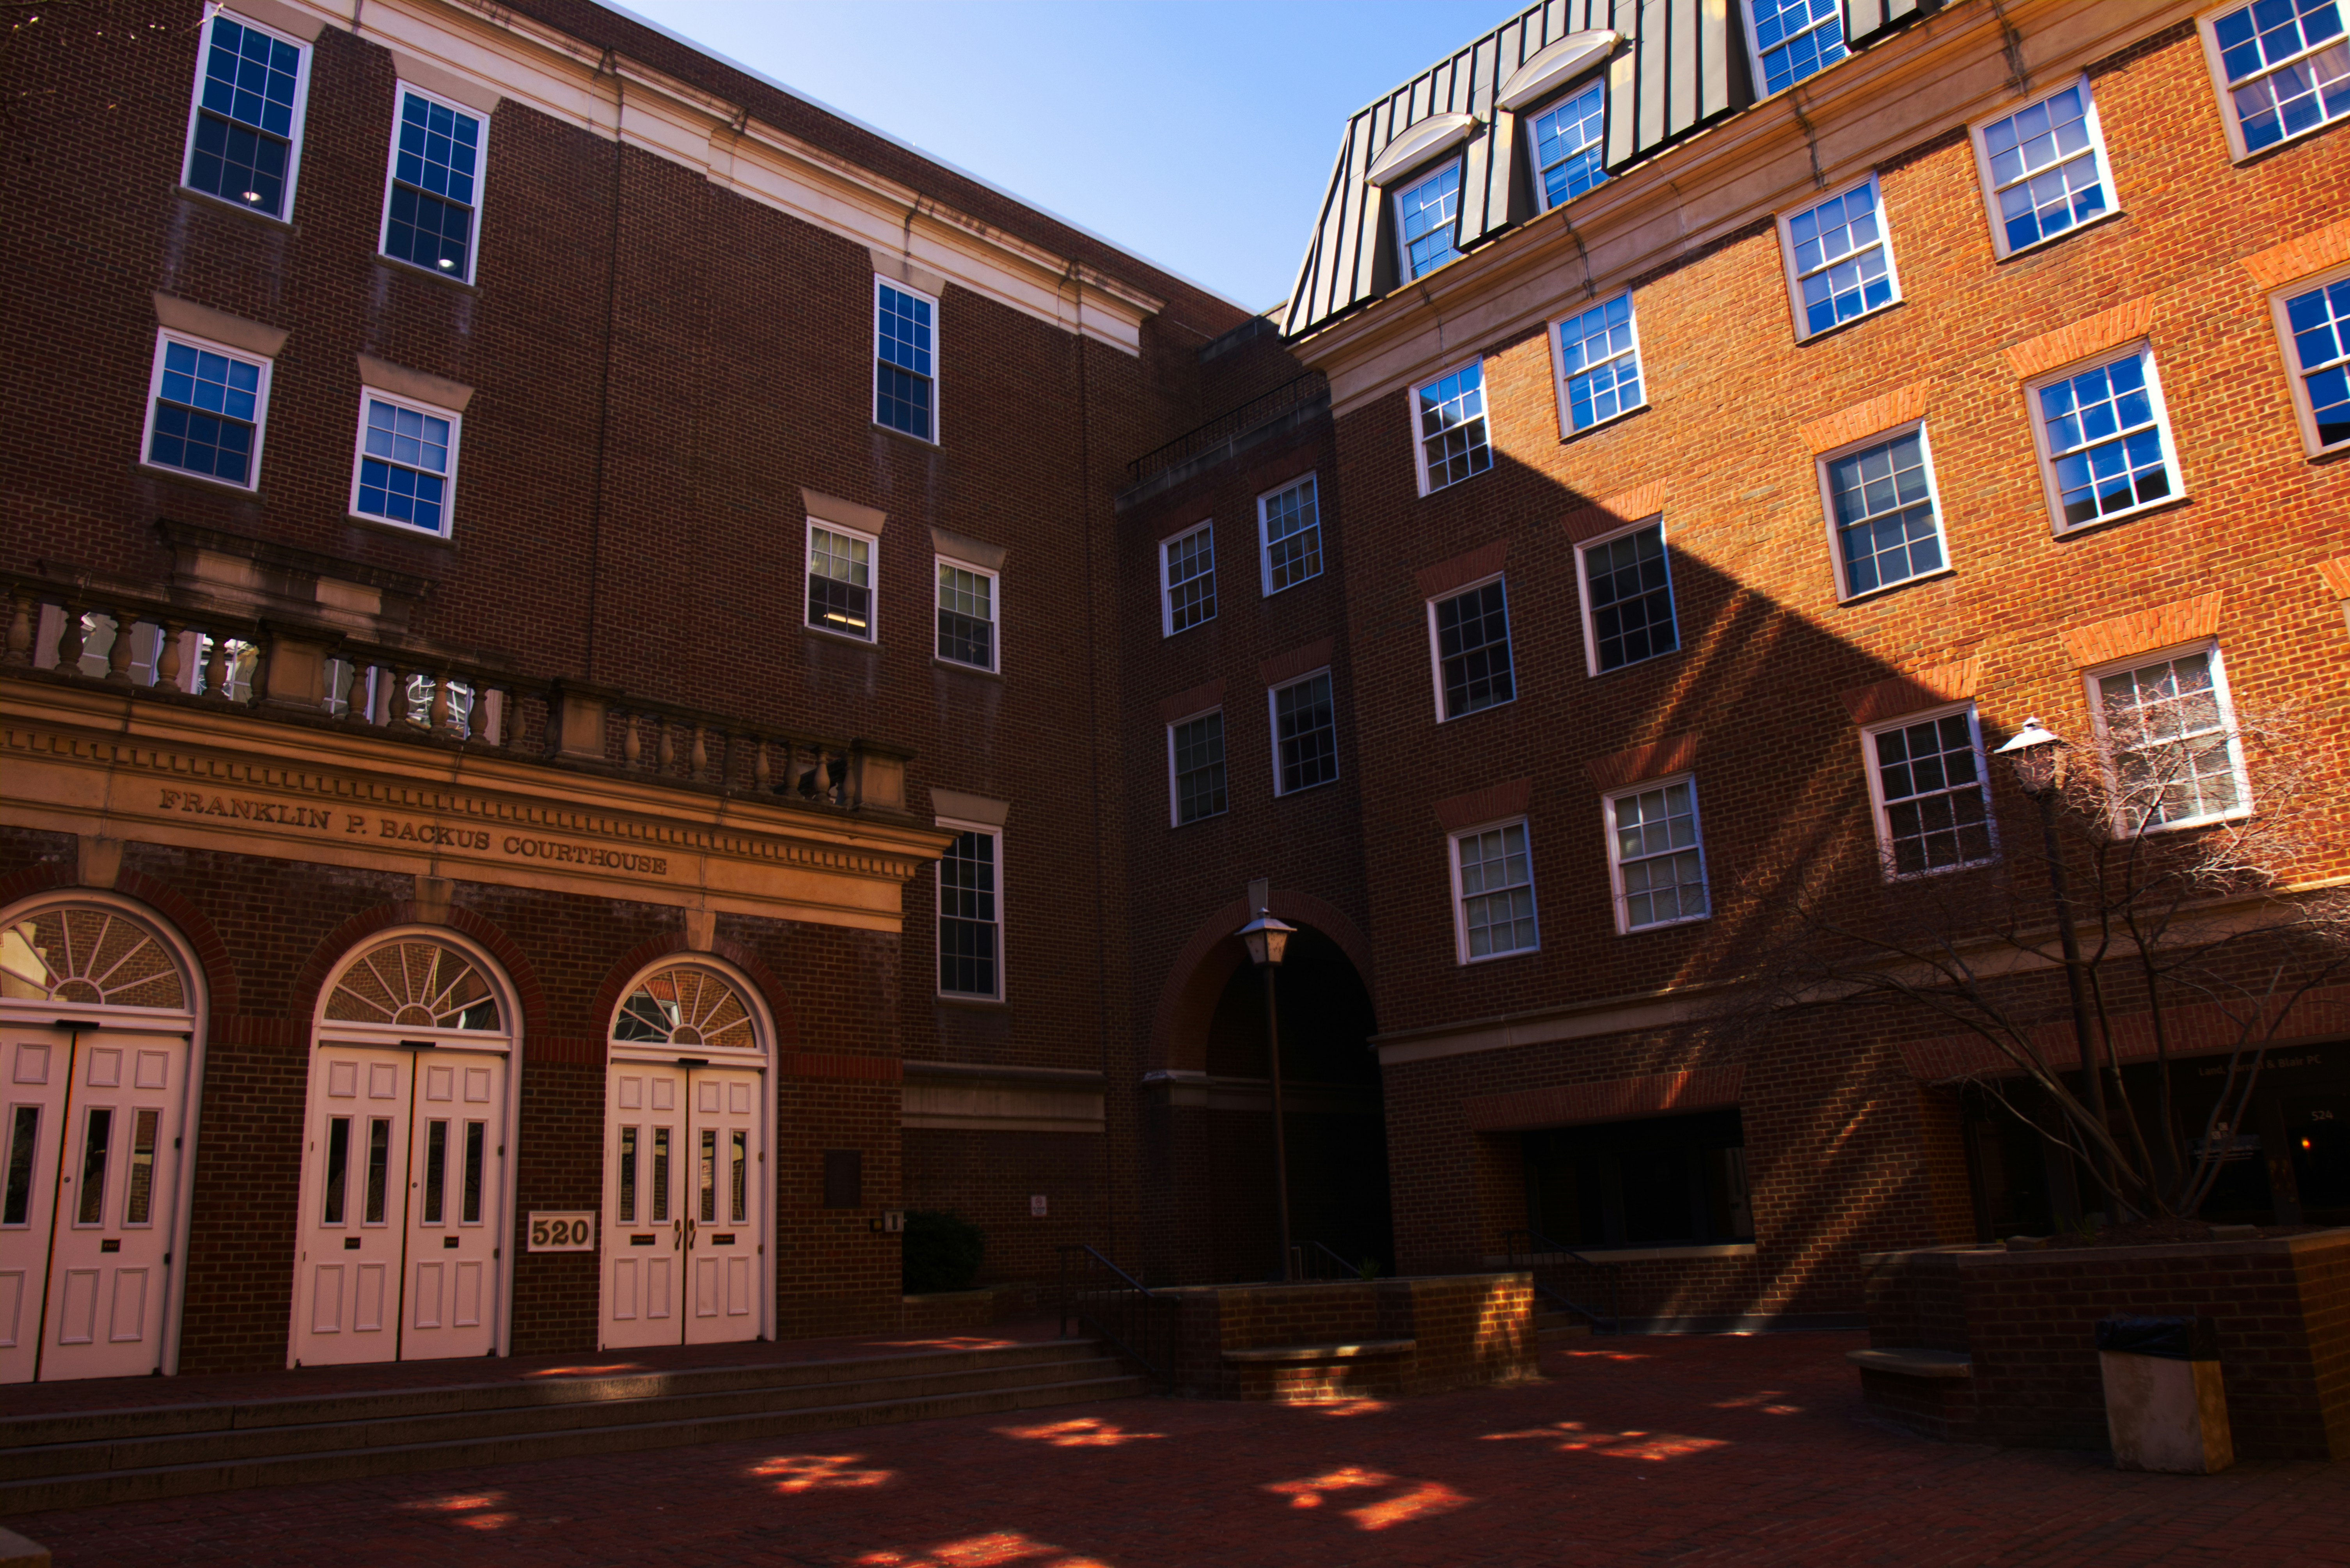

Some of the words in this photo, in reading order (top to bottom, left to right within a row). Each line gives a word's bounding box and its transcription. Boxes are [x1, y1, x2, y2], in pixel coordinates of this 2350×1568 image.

[159, 789, 331, 829] FRANKLIN
[346, 814, 367, 834] P.
[380, 819, 490, 850] BACKUS
[504, 837, 667, 875] COURTHOUSE
[2228, 1059, 2264, 1072] arrl
[2267, 1059, 2275, 1069] &
[2278, 1057, 2304, 1068] Blair
[2306, 1054, 2322, 1064] PC
[2311, 1110, 2333, 1121] 524
[533, 1219, 589, 1245] 520
